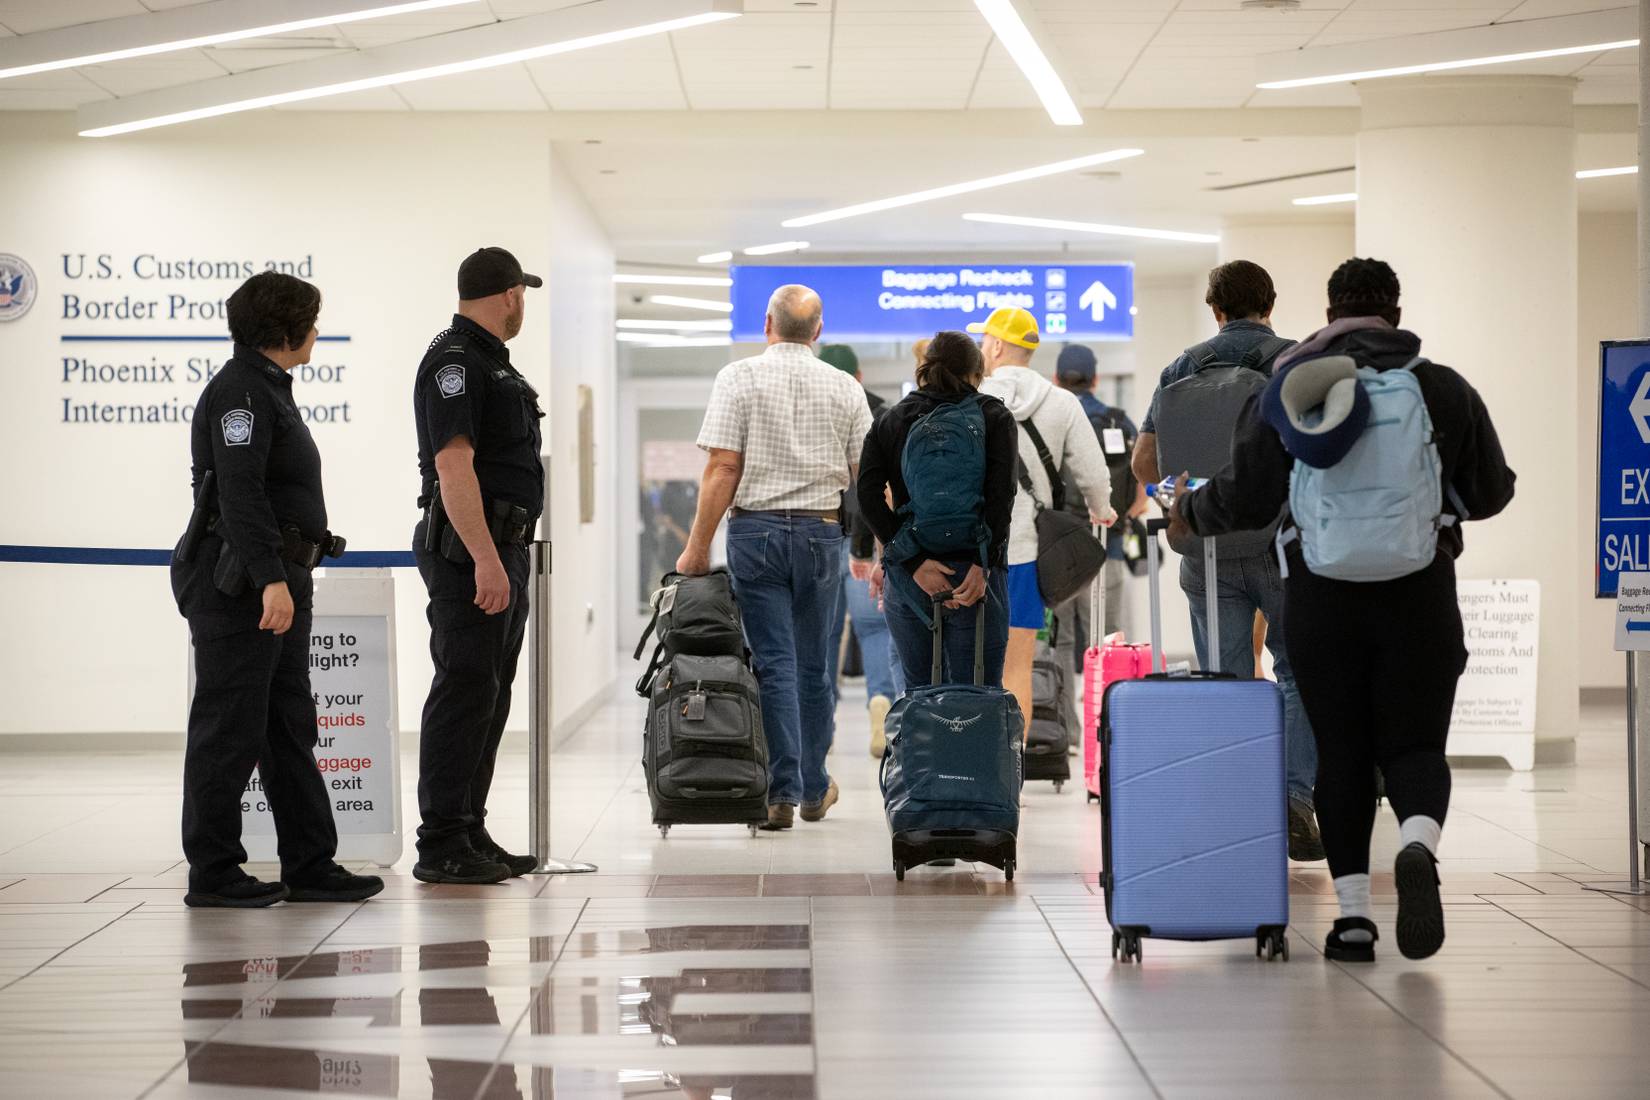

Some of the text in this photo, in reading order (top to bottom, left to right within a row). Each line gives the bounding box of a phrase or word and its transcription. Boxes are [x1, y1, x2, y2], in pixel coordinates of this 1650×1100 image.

[61, 254, 314, 280] U.S. Customs and
[881, 269, 1034, 290] Baggage Recheck
[61, 294, 226, 320] Border Prot
[878, 291, 975, 312] Connecting
[61, 357, 174, 384] Phoenix
[187, 357, 220, 383] Sk
[290, 362, 346, 383] rbor
[61, 398, 195, 424] Internatio
[298, 399, 352, 423] port
[1621, 468, 1650, 505] EX
[1604, 533, 1650, 571] SAL
[1458, 592, 1529, 606] engers Must
[1621, 587, 1641, 597] Baggage
[1619, 603, 1645, 614] Connecting
[1463, 609, 1535, 624] eir Luggage
[312, 632, 357, 650] ng to
[1468, 627, 1518, 642] Clearing
[1508, 645, 1534, 657] And
[309, 653, 360, 671] light?
[1466, 663, 1518, 675] rotection
[325, 694, 364, 709] your
[318, 712, 366, 729] quids
[318, 737, 336, 748] ur
[317, 757, 372, 772] ggage
[331, 776, 363, 790] exit
[336, 800, 374, 811] area
